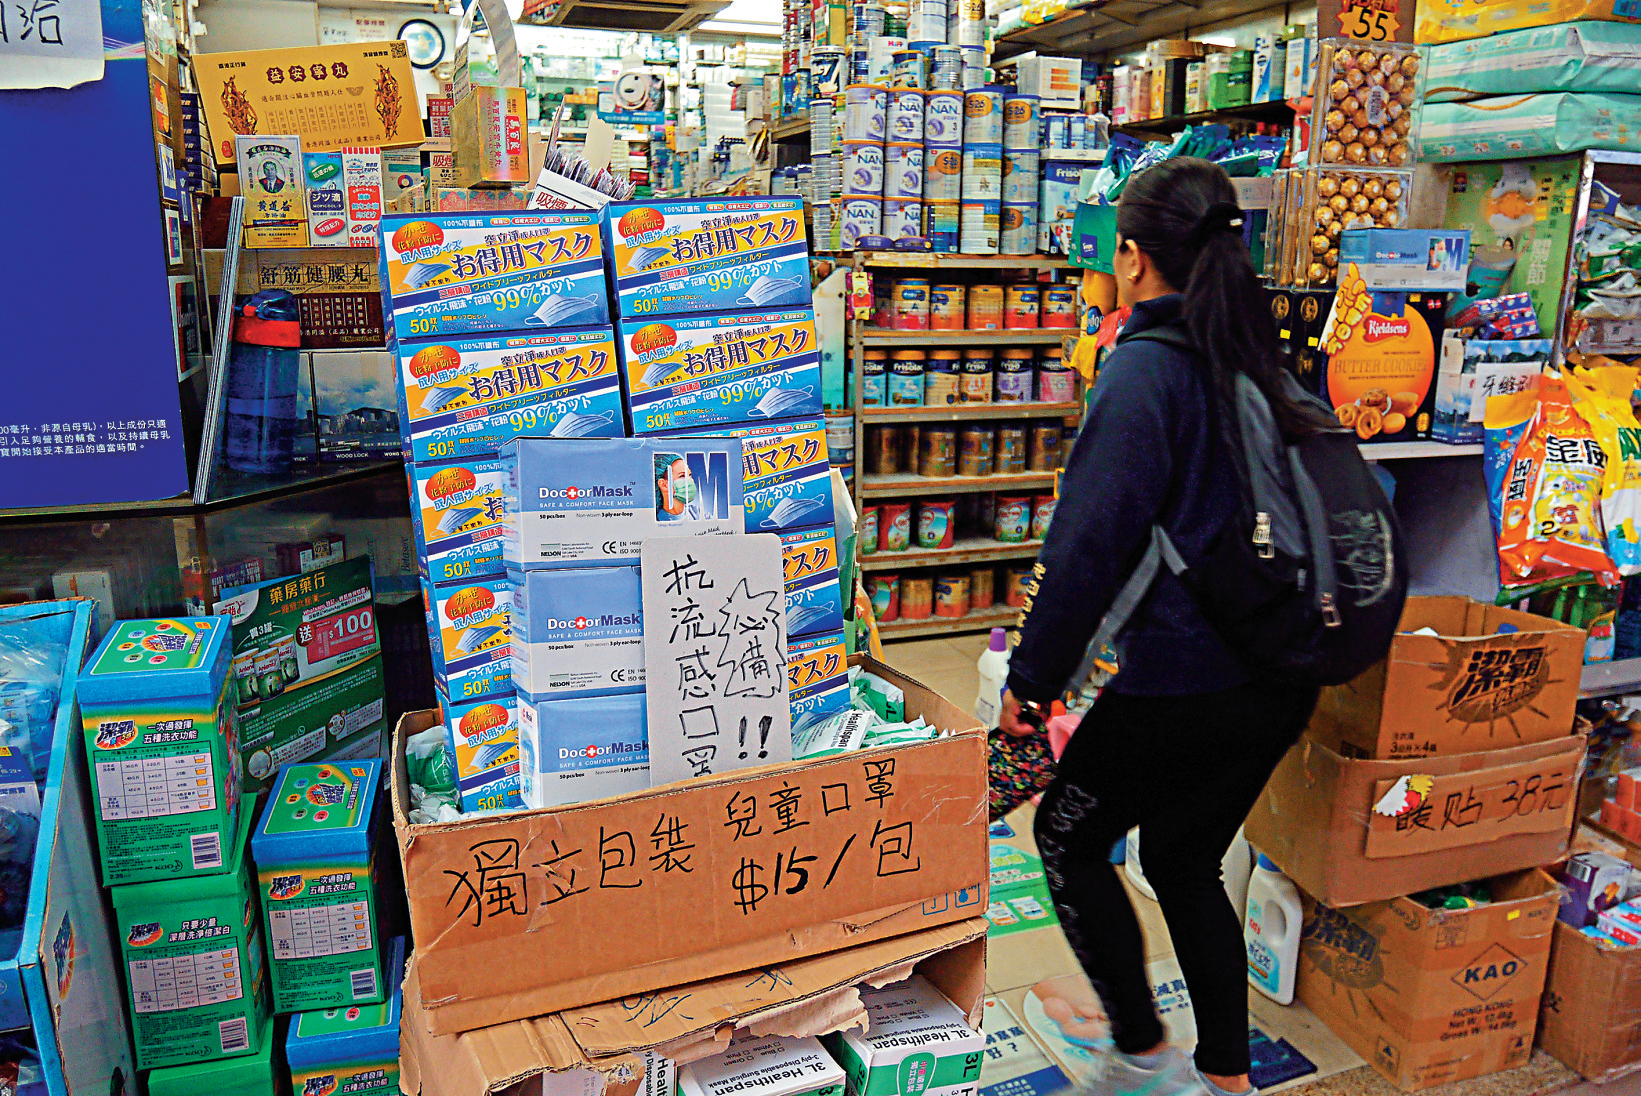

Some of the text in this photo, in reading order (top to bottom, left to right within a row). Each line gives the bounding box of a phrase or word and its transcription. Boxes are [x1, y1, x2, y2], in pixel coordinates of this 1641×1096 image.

[1352, 8, 1388, 41] 55
[266, 61, 349, 84] 益安寧丸
[931, 105, 958, 115] NAN
[628, 209, 650, 224] かぜ
[847, 209, 875, 219] NAN
[402, 222, 427, 239] かぜ
[626, 224, 682, 248] 成人用サイズ
[670, 217, 798, 262] お得用マスク
[400, 239, 463, 264] 成人用サイズ
[451, 232, 593, 279] お得用マスク
[261, 264, 369, 285] 舒筋健腰丸
[707, 269, 751, 293] 99%
[493, 286, 542, 312] 99%
[633, 300, 652, 313] 50
[410, 319, 430, 334] 50
[639, 325, 663, 340] かぜ
[1369, 320, 1408, 338] Kjeldsens
[419, 346, 445, 364] かぜ
[638, 339, 694, 365] 成人用サイズ
[682, 328, 809, 376] お得用マスク
[417, 362, 480, 388] 成人用サイズ
[467, 350, 608, 402] お得用マスク
[1334, 359, 1381, 374] BUTTER
[719, 381, 763, 405] 99%
[509, 408, 558, 433] 99%
[646, 415, 664, 428] 50
[427, 442, 448, 457] 50
[444, 563, 463, 578] 50
[269, 571, 326, 605] 藥房藥行
[299, 625, 313, 643] 送
[143, 730, 199, 744] 五種洗衣功能
[585, 758, 615, 766] COMFORT
[443, 812, 696, 927] 獨立包裝
[724, 757, 897, 842] 兒童口罩
[1464, 960, 1518, 985] KAO
[873, 1031, 951, 1050] Healthspan
[760, 1059, 801, 1074] Disposable
[708, 1079, 730, 1089] Mask
[714, 1062, 826, 1096] 3L Healthspan
[731, 1071, 760, 1083] Surgical
